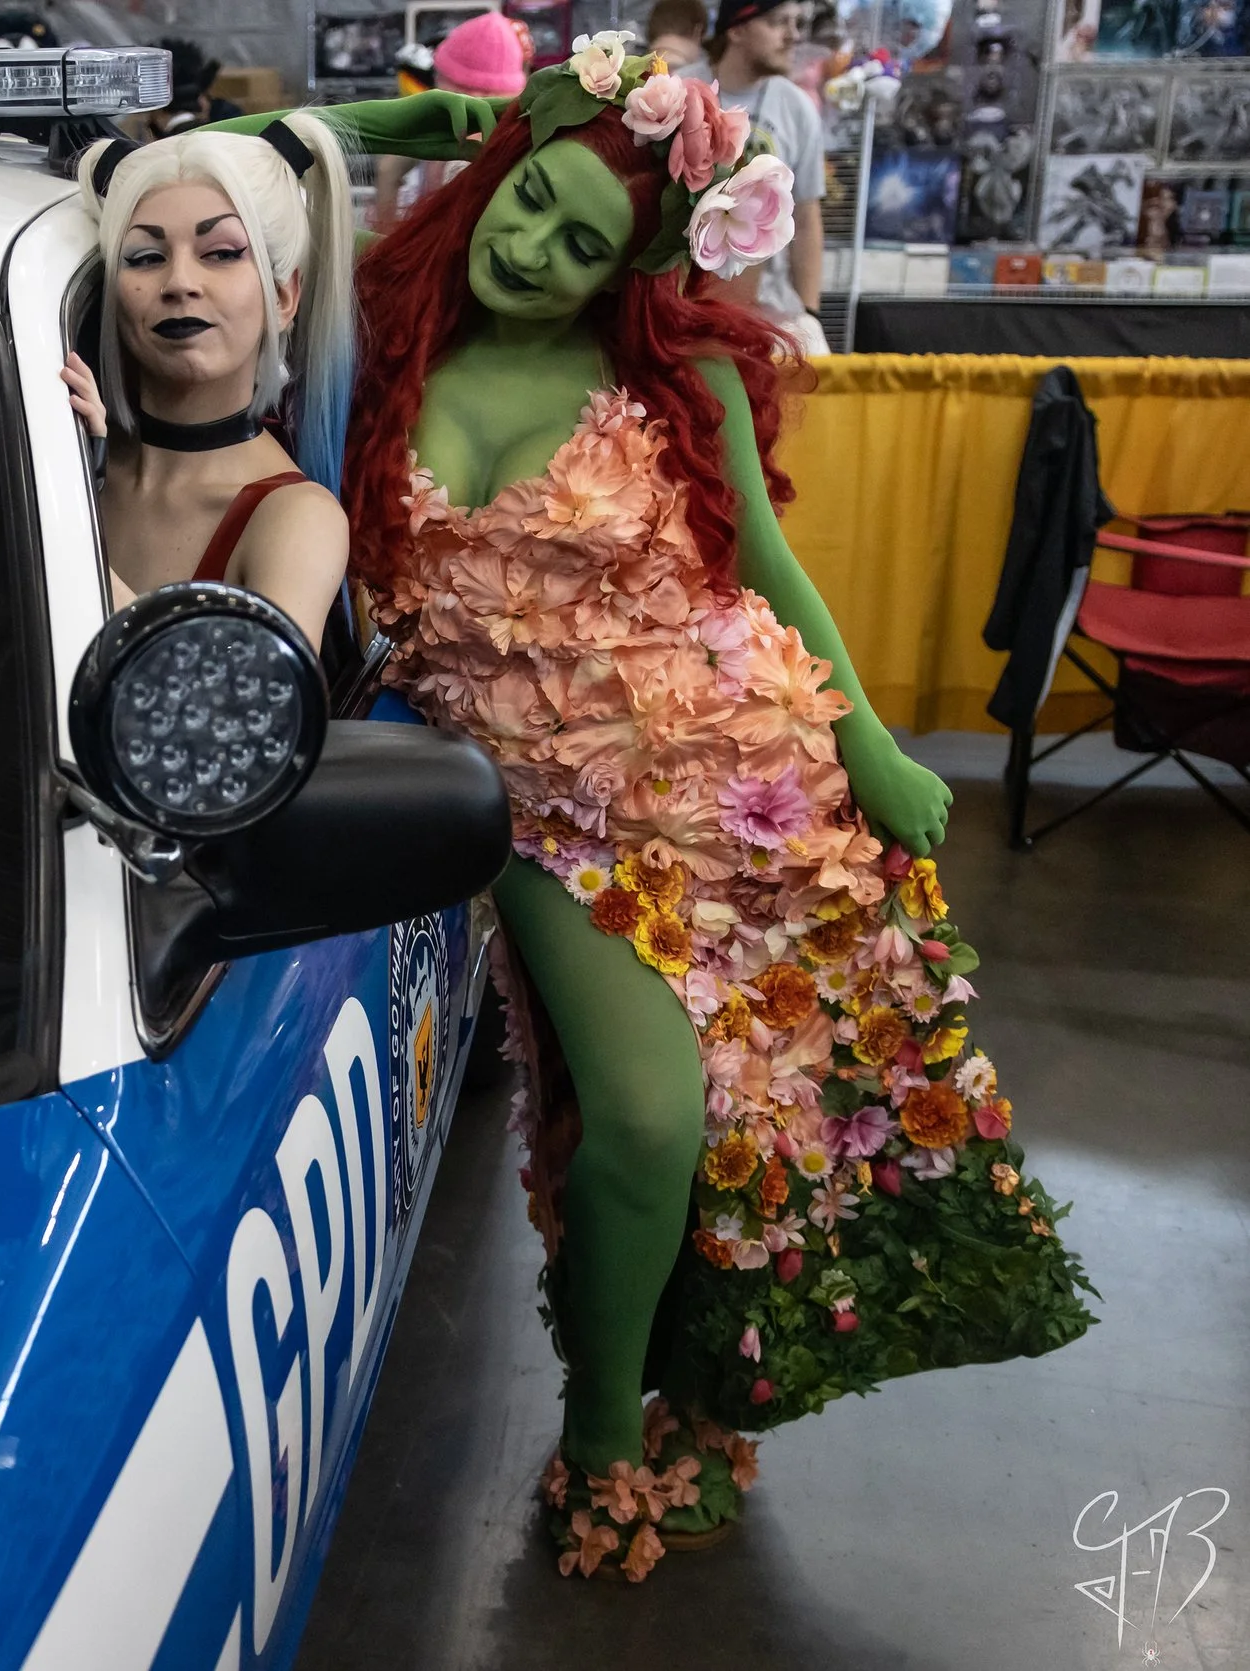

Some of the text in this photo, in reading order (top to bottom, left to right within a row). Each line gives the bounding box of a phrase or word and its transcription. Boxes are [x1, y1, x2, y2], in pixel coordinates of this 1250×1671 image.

[391, 920, 405, 1059] GOTHAM
[392, 1075, 400, 1123] OF
[226, 995, 388, 1656] GPD
